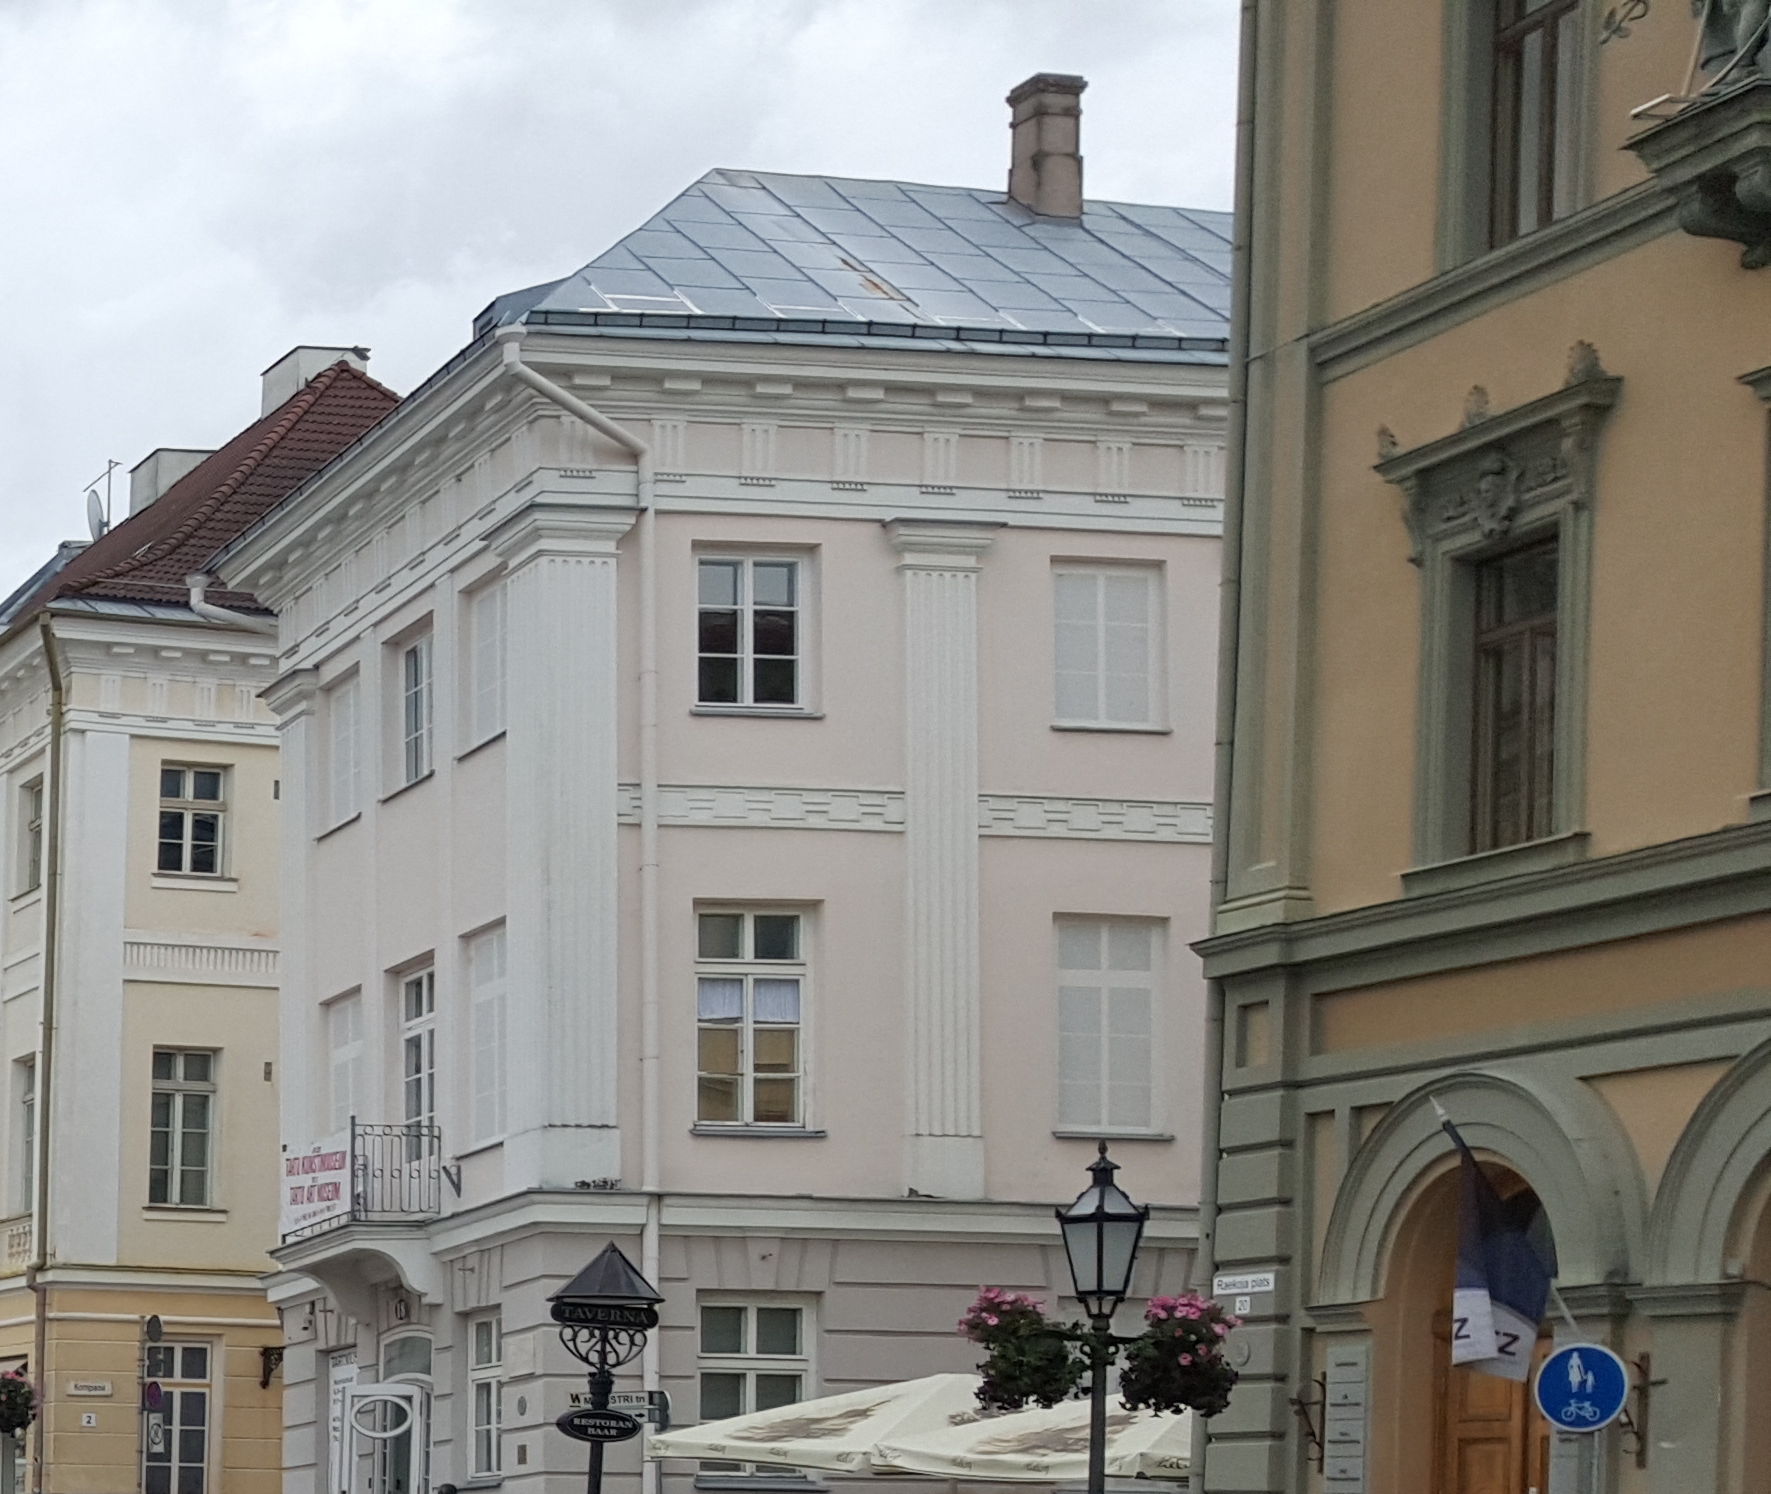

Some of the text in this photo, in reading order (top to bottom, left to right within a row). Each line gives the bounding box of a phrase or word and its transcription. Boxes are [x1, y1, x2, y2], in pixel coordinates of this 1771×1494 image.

[561, 1306, 648, 1324] TAVERNA
[86, 1415, 92, 1424] 2
[573, 1418, 633, 1429] RESTORAN
[587, 1427, 618, 1436] BAAR
